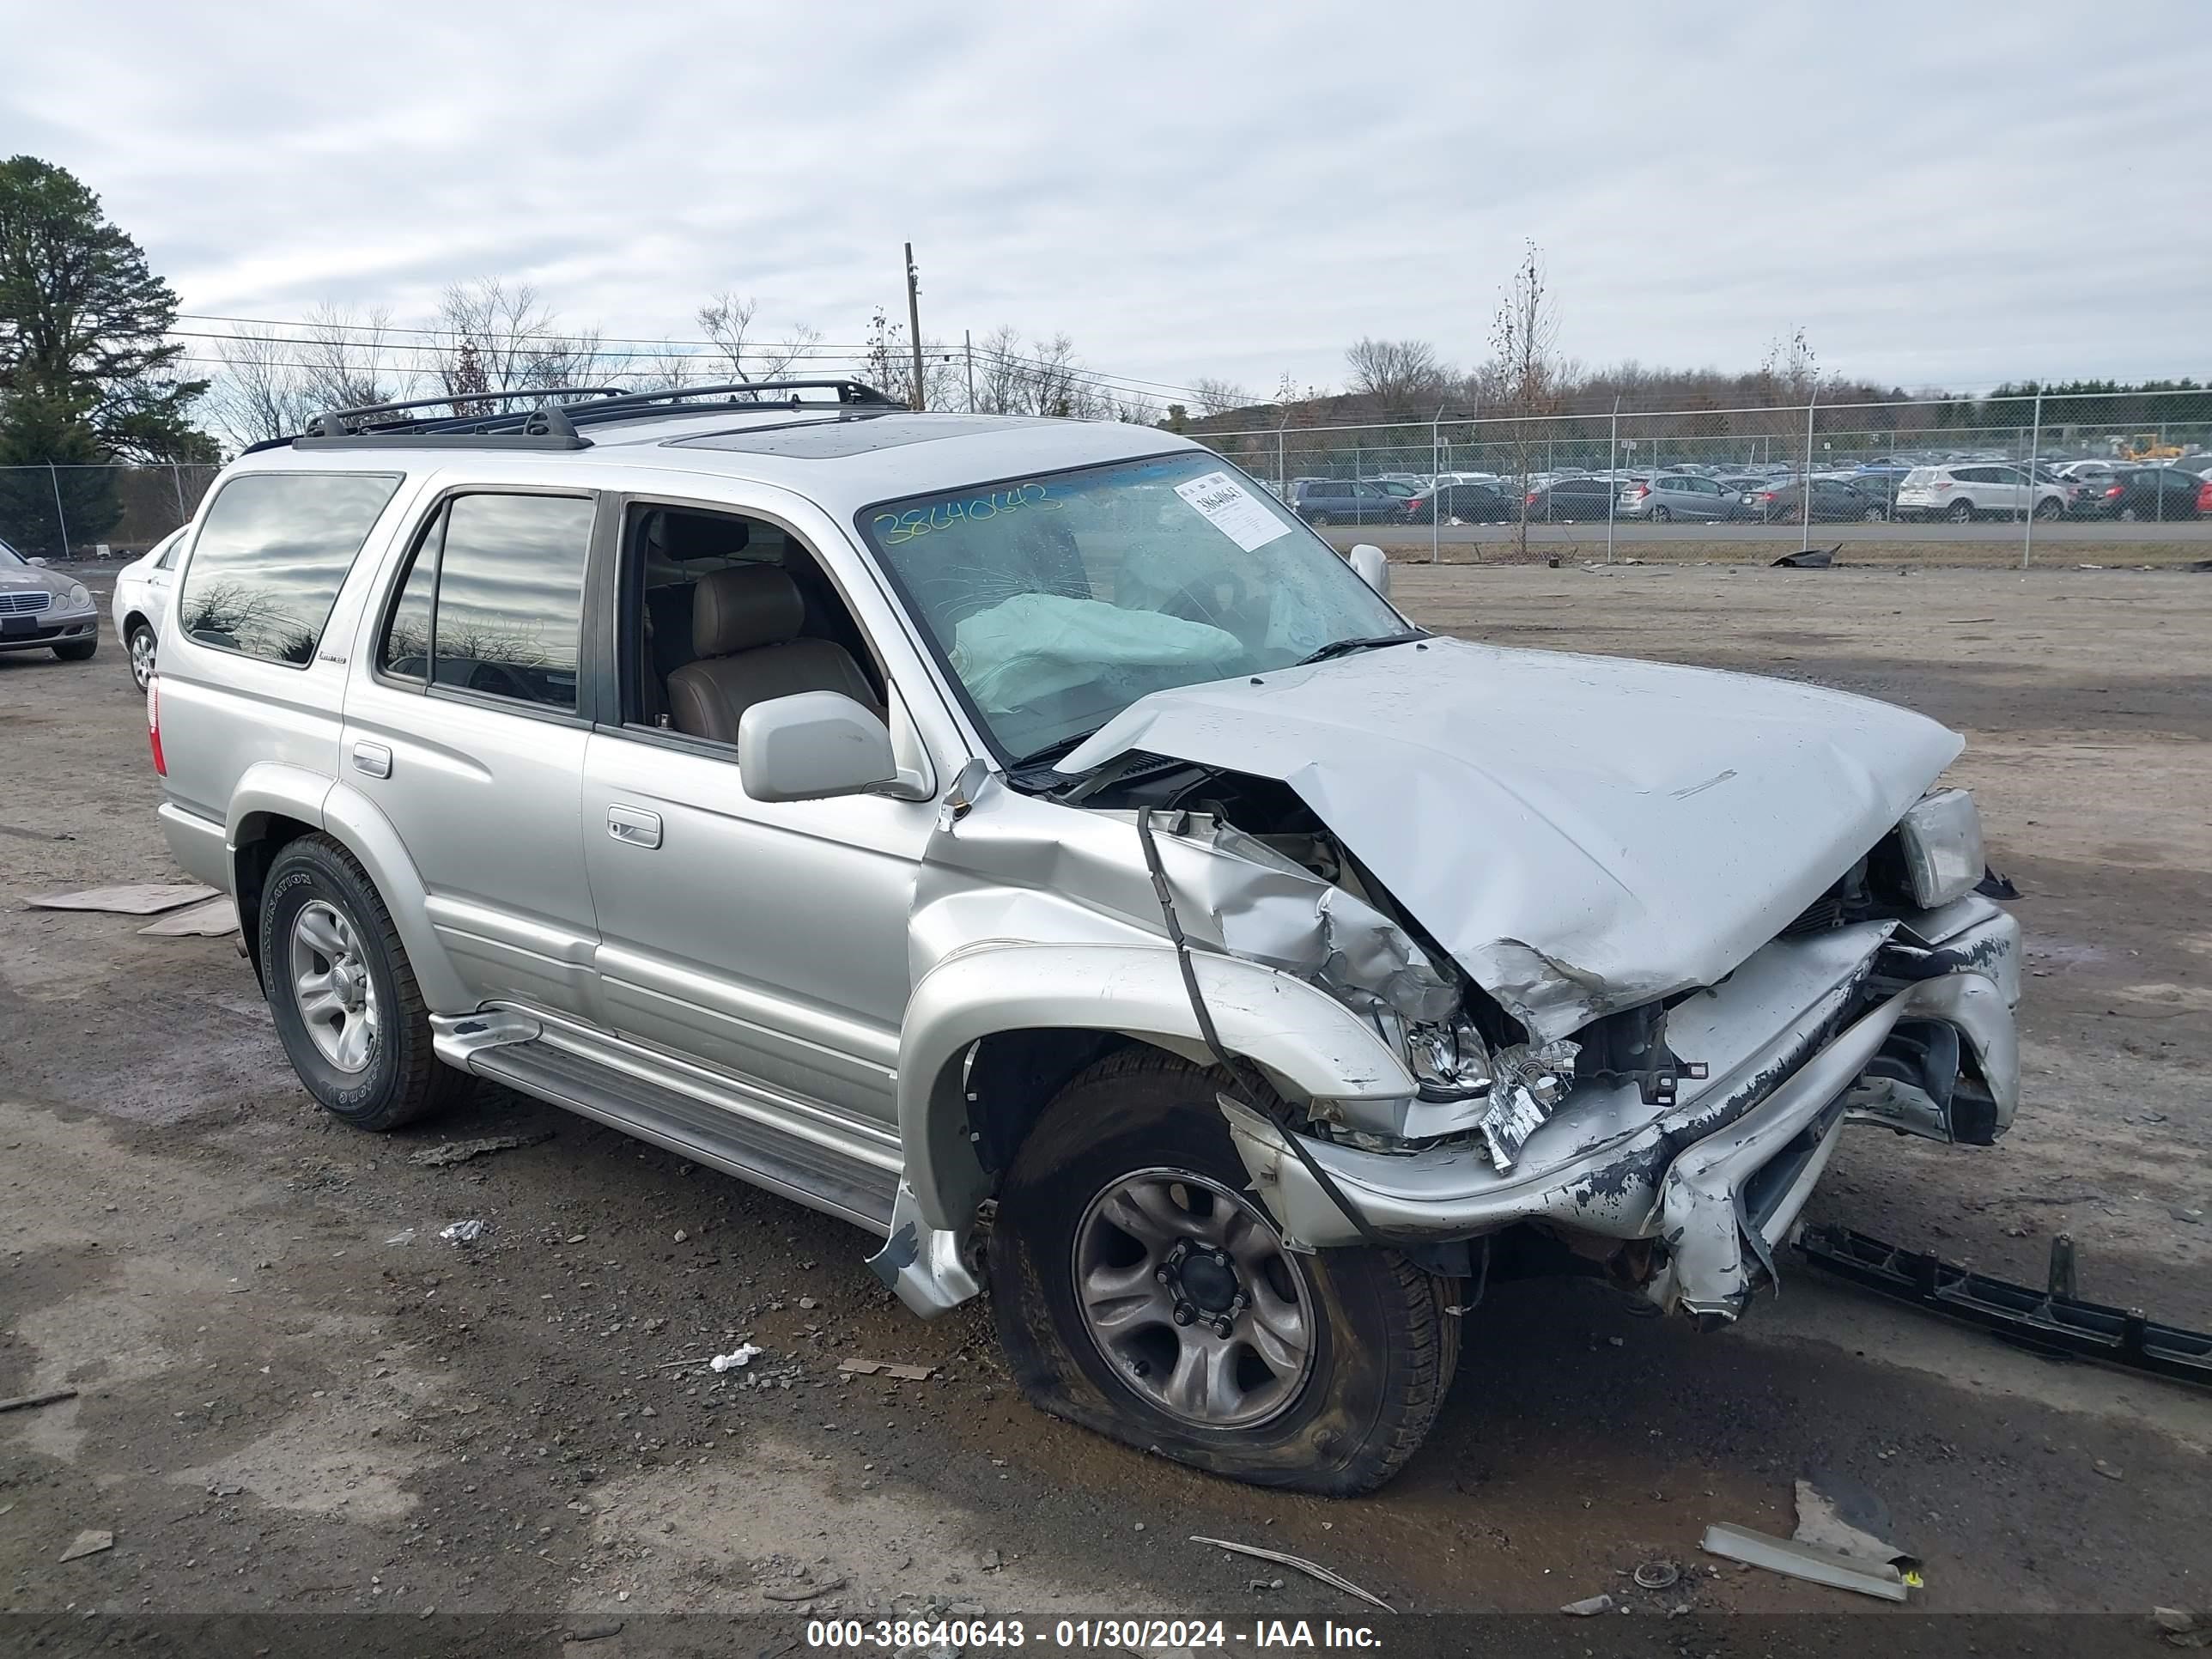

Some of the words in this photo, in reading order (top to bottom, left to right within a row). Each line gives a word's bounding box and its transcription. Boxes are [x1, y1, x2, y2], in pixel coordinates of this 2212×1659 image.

[873, 483, 1063, 544] 38640643
[1196, 486, 1243, 513] 38640643
[264, 873, 312, 993] DESTINATION
[338, 1006, 384, 1104] estone
